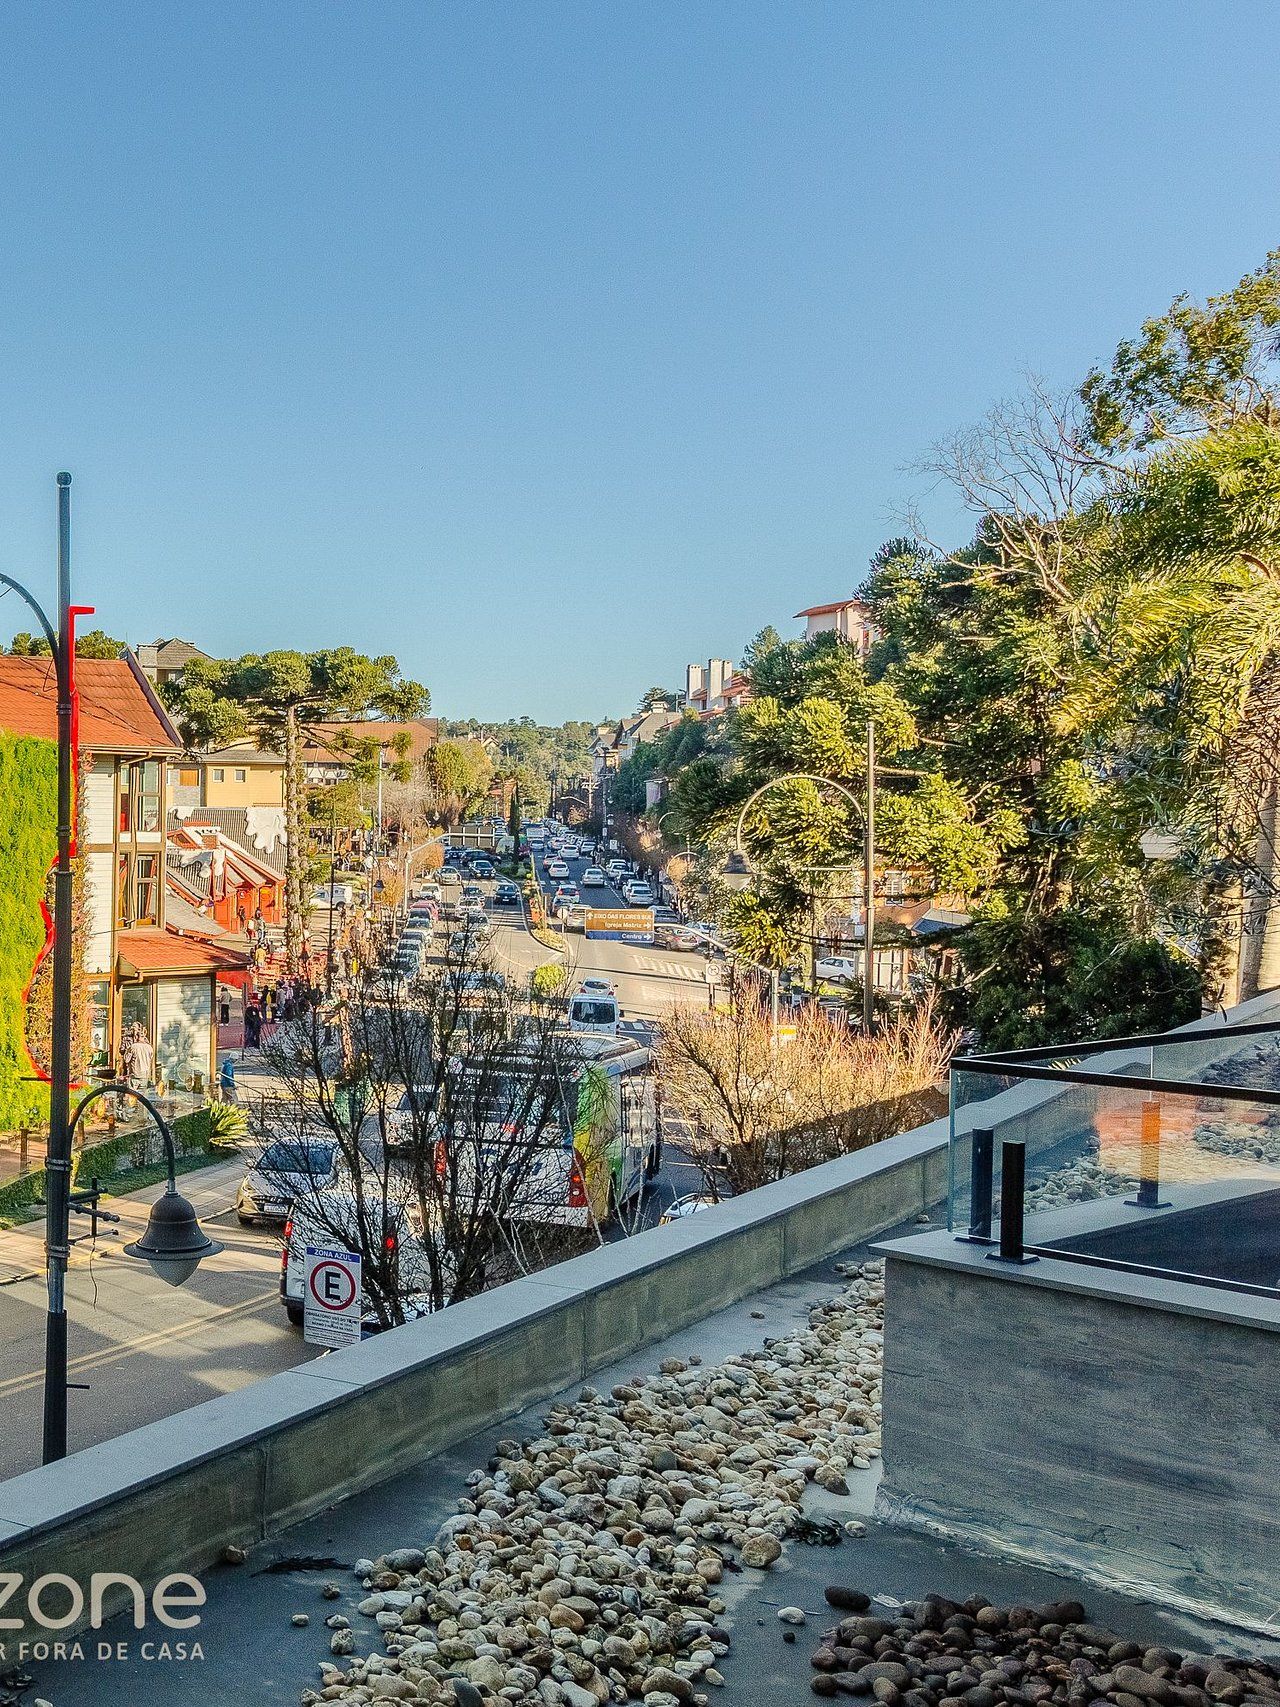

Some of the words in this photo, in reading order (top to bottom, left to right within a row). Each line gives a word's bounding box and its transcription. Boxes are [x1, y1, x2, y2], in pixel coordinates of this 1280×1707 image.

[314, 1248, 333, 1258] ZONA
[334, 1251, 352, 1260] AZUL
[325, 1270, 340, 1301] E
